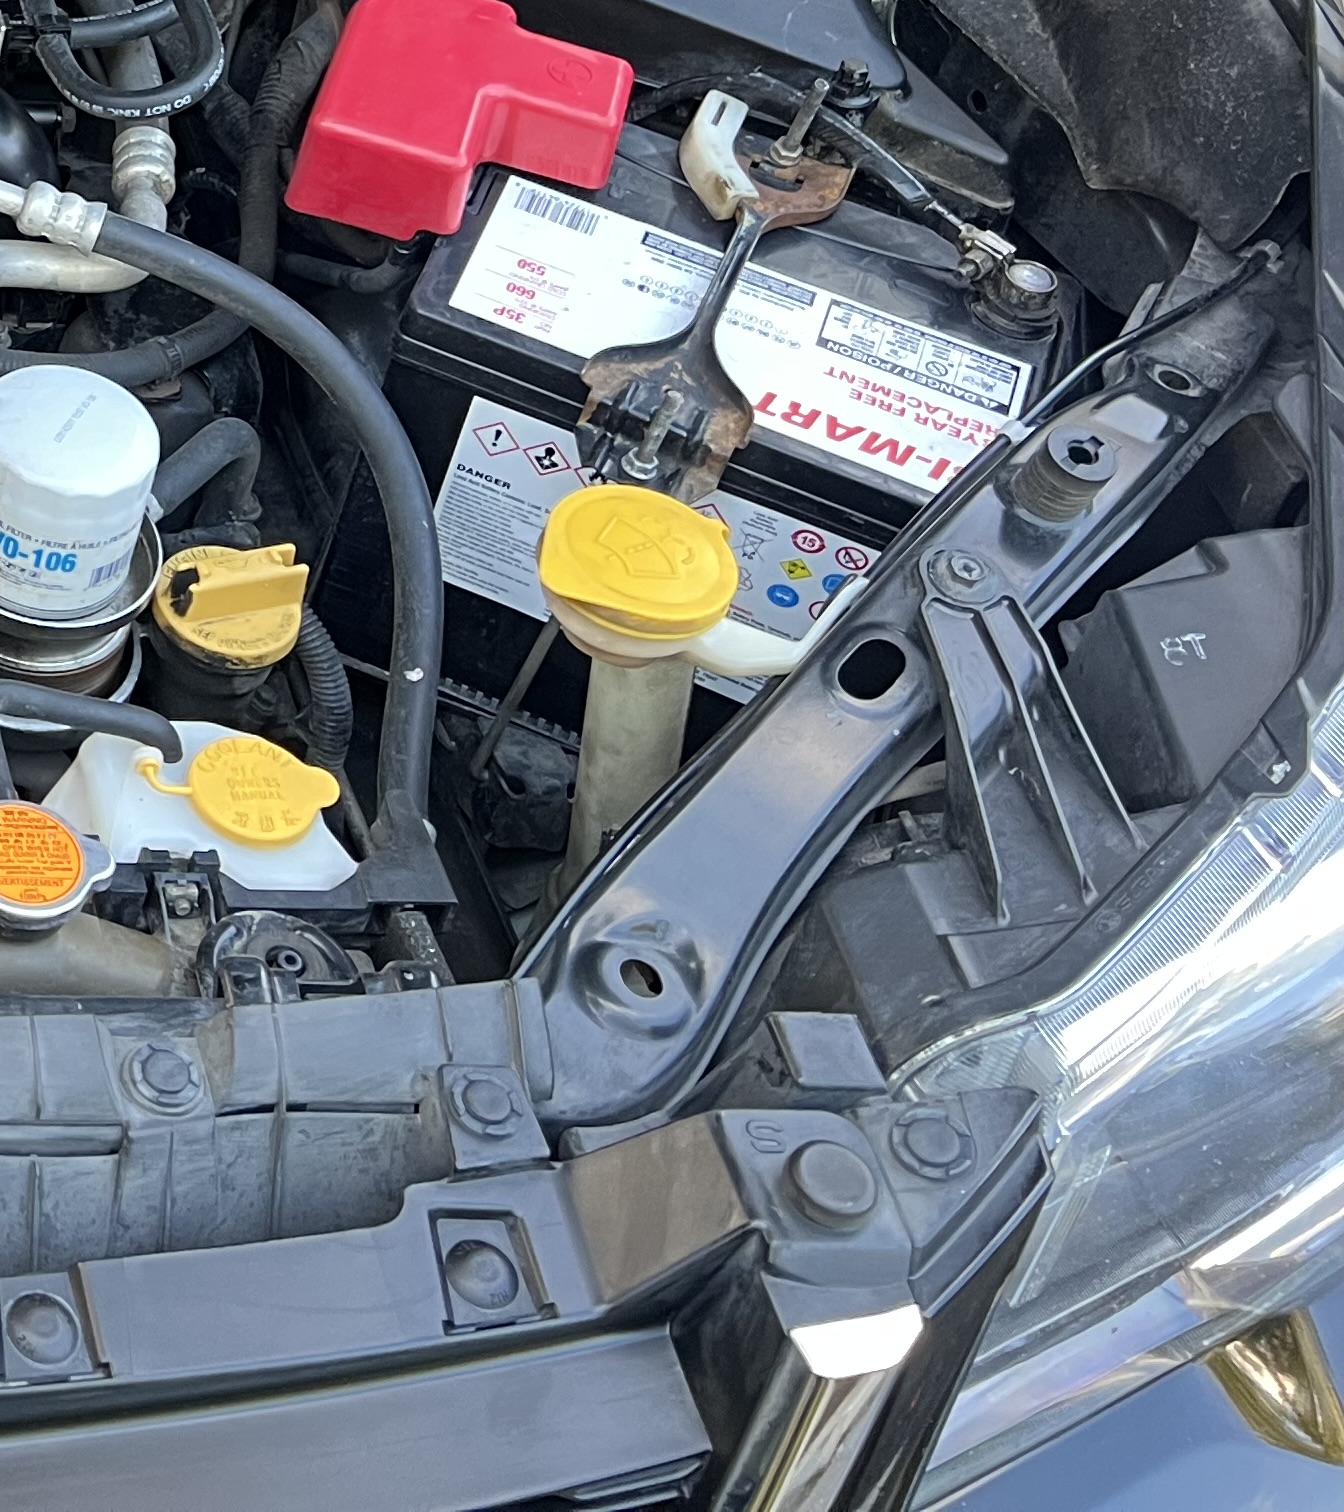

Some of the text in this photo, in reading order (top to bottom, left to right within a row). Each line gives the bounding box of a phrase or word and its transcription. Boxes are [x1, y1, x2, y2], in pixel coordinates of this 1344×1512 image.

[144, 104, 172, 117] NOT
[516, 258, 547, 277] 550
[505, 281, 536, 300] 660
[492, 306, 526, 324] 35P
[826, 341, 895, 375] POISON
[903, 370, 981, 403] DANGER
[823, 366, 1001, 438] REPLACEMENT
[848, 387, 979, 447] YEAR FREE
[456, 463, 511, 490] DANGER
[6, 525, 32, 542] FILTER
[40, 539, 68, 550] FILTRE
[800, 535, 818, 549] 15
